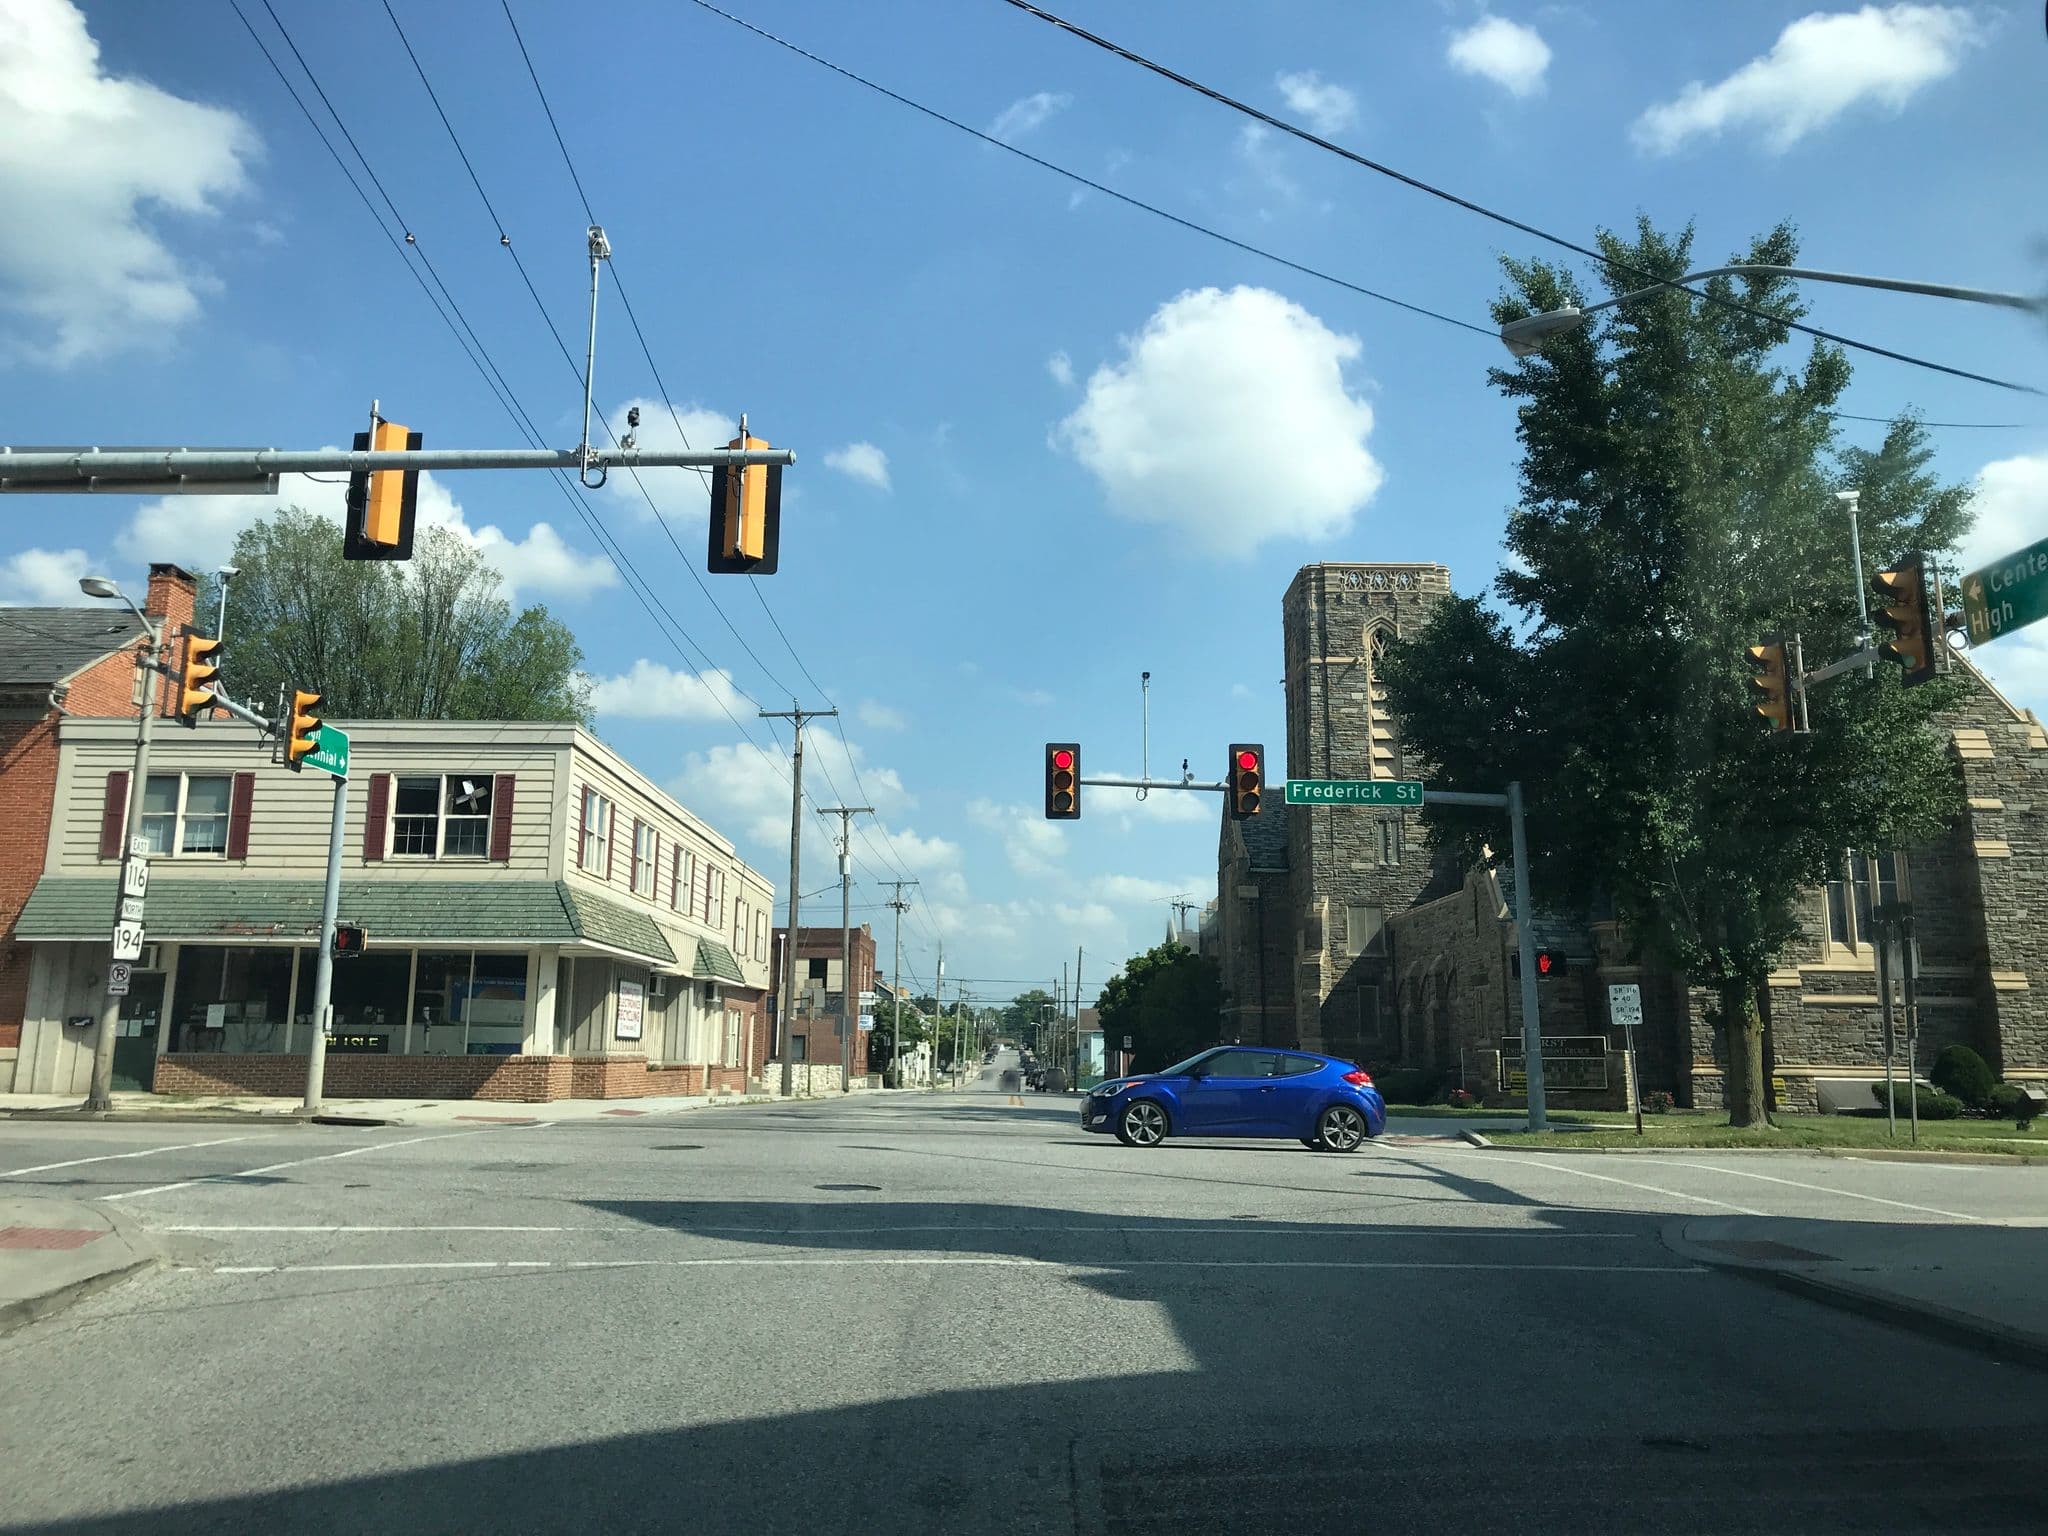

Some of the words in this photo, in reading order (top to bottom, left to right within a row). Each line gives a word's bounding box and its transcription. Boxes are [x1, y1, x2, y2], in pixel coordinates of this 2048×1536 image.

[1971, 600, 2014, 635] High
[1293, 784, 1382, 799] Frederick
[1396, 785, 1416, 799] St
[133, 838, 147, 850] EAST
[128, 865, 146, 888] 116
[124, 902, 142, 914] NORTH
[116, 929, 141, 951] 194
